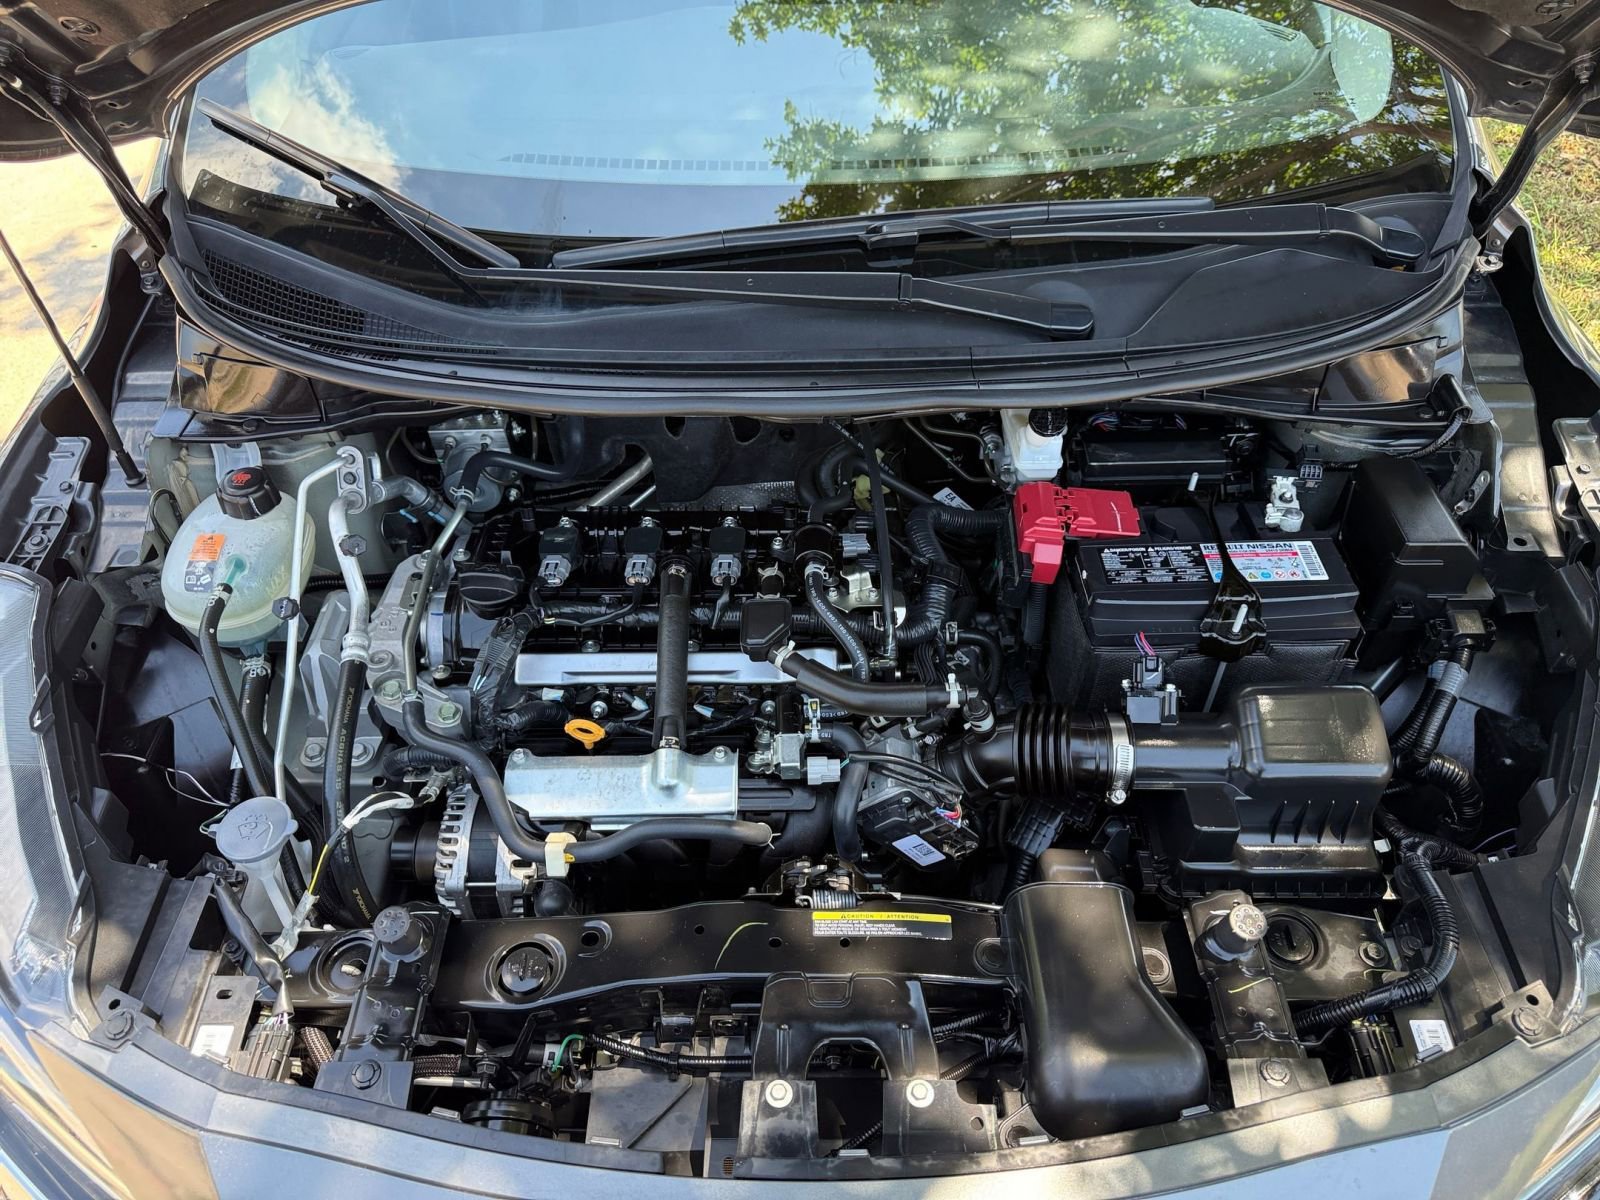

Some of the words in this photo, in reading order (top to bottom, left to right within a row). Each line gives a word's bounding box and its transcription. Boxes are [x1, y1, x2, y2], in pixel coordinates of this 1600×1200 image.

[945, 492, 957, 503] EA
[343, 693, 353, 724] YOKOHAMA
[355, 895, 372, 920] YOKOHAMA
